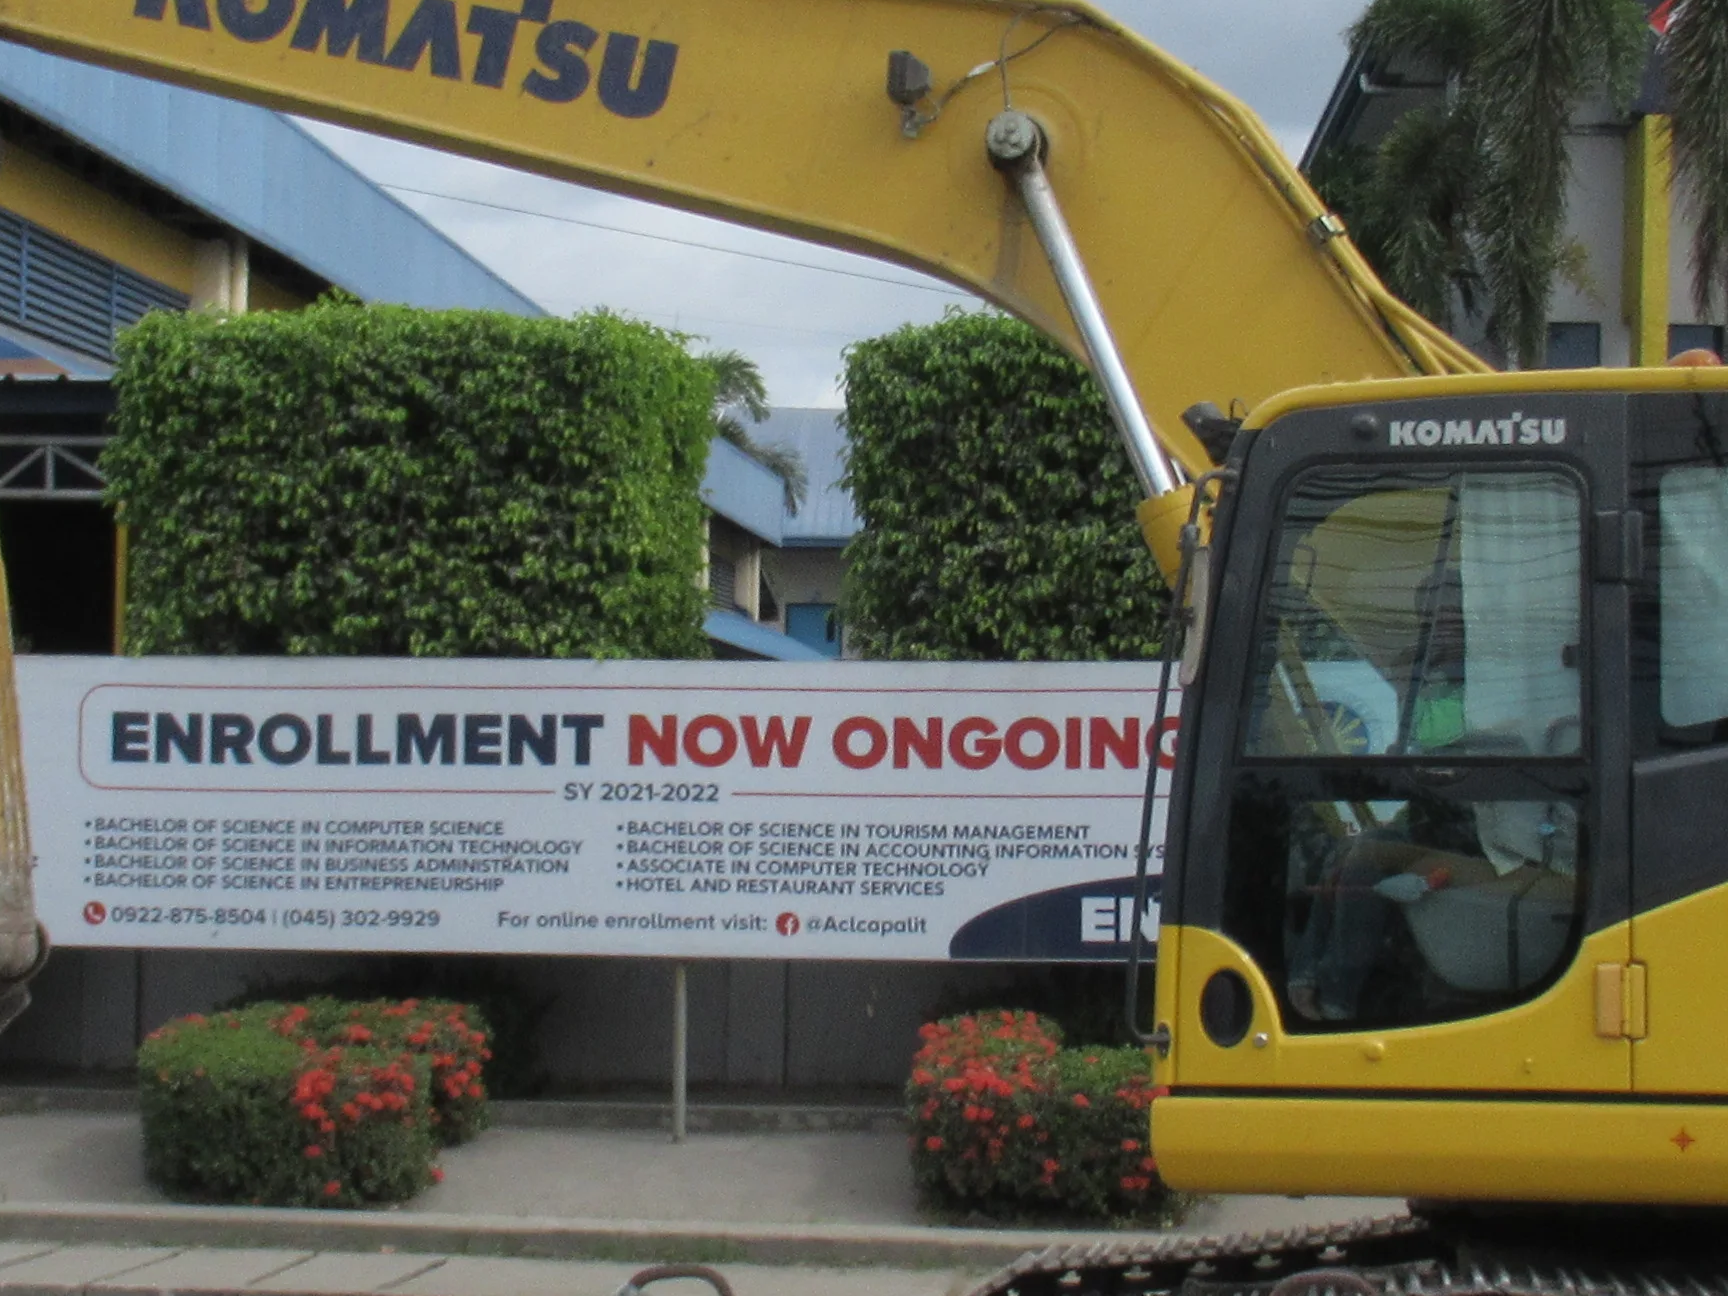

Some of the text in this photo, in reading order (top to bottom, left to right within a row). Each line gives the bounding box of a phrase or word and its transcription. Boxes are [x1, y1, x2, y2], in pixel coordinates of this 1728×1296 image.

[1389, 411, 1566, 446] KOMATSU
[111, 710, 605, 767] ENROLLMENT
[628, 713, 813, 769] NOW
[564, 783, 720, 803] SY 2021-2022
[94, 817, 505, 836] BACHELOR OF SCIENCE IN COMPUTER SCIENCE
[627, 821, 1091, 841] BACHELOR OF SCIENCE IN TOURISM MANAGEMENT
[94, 836, 584, 855] BACHELOR OF SCIENCE IN INFORMATION TECHNOLOGY
[627, 840, 723, 855] BACHELOR
[728, 841, 754, 856] OF
[758, 841, 835, 857] SCIENCE
[841, 842, 860, 857] IN
[865, 843, 990, 859] ACCOUNTING
[996, 844, 1128, 859] INFORMATION
[94, 854, 570, 874] BACHELOR OF SCIENCE IN BUSINESS ADMINISTRATION
[627, 858, 990, 878] ASSOCIATE IN COMPUTER TECHNOLOGY
[94, 873, 505, 892] BACHELOR OF SCIENCE IN ENTREPRENEURSHIP
[626, 877, 945, 896] HOTEL AND RESTAURANT SERVICES
[110, 907, 266, 926] 0922-875-8504
[282, 908, 335, 929] (045)
[341, 908, 441, 927] 302-9929
[497, 911, 927, 937] For online enrollment visit: @Aclcapalit
